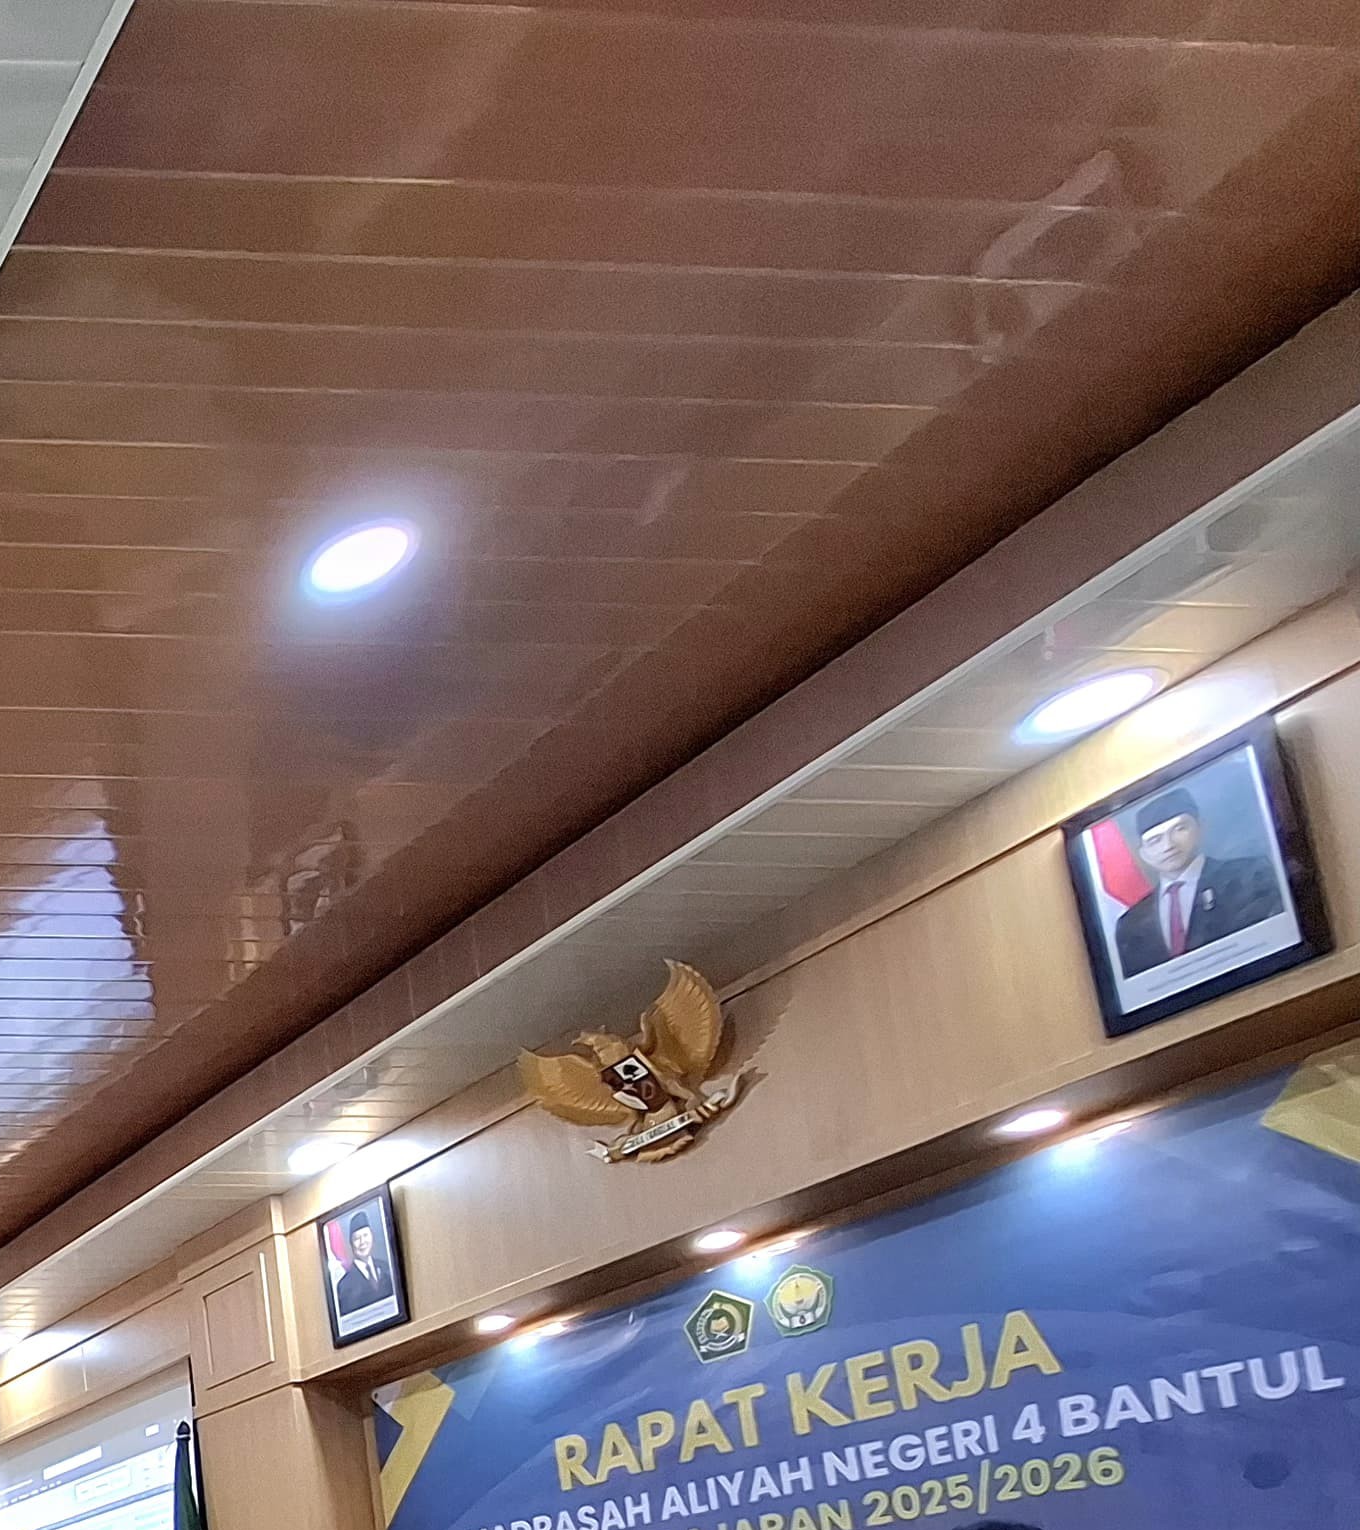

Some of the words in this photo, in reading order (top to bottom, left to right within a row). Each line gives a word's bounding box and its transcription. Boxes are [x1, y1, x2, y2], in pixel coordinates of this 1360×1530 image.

[554, 1383, 766, 1491] RAPAT
[786, 1310, 1063, 1435] KERJA
[661, 1456, 814, 1520] ALIYAH
[822, 1414, 999, 1487] NEGERI
[1012, 1403, 1046, 1444] 4
[1057, 1345, 1346, 1438] BANTUL
[862, 1446, 1124, 1528] 2025/2026
